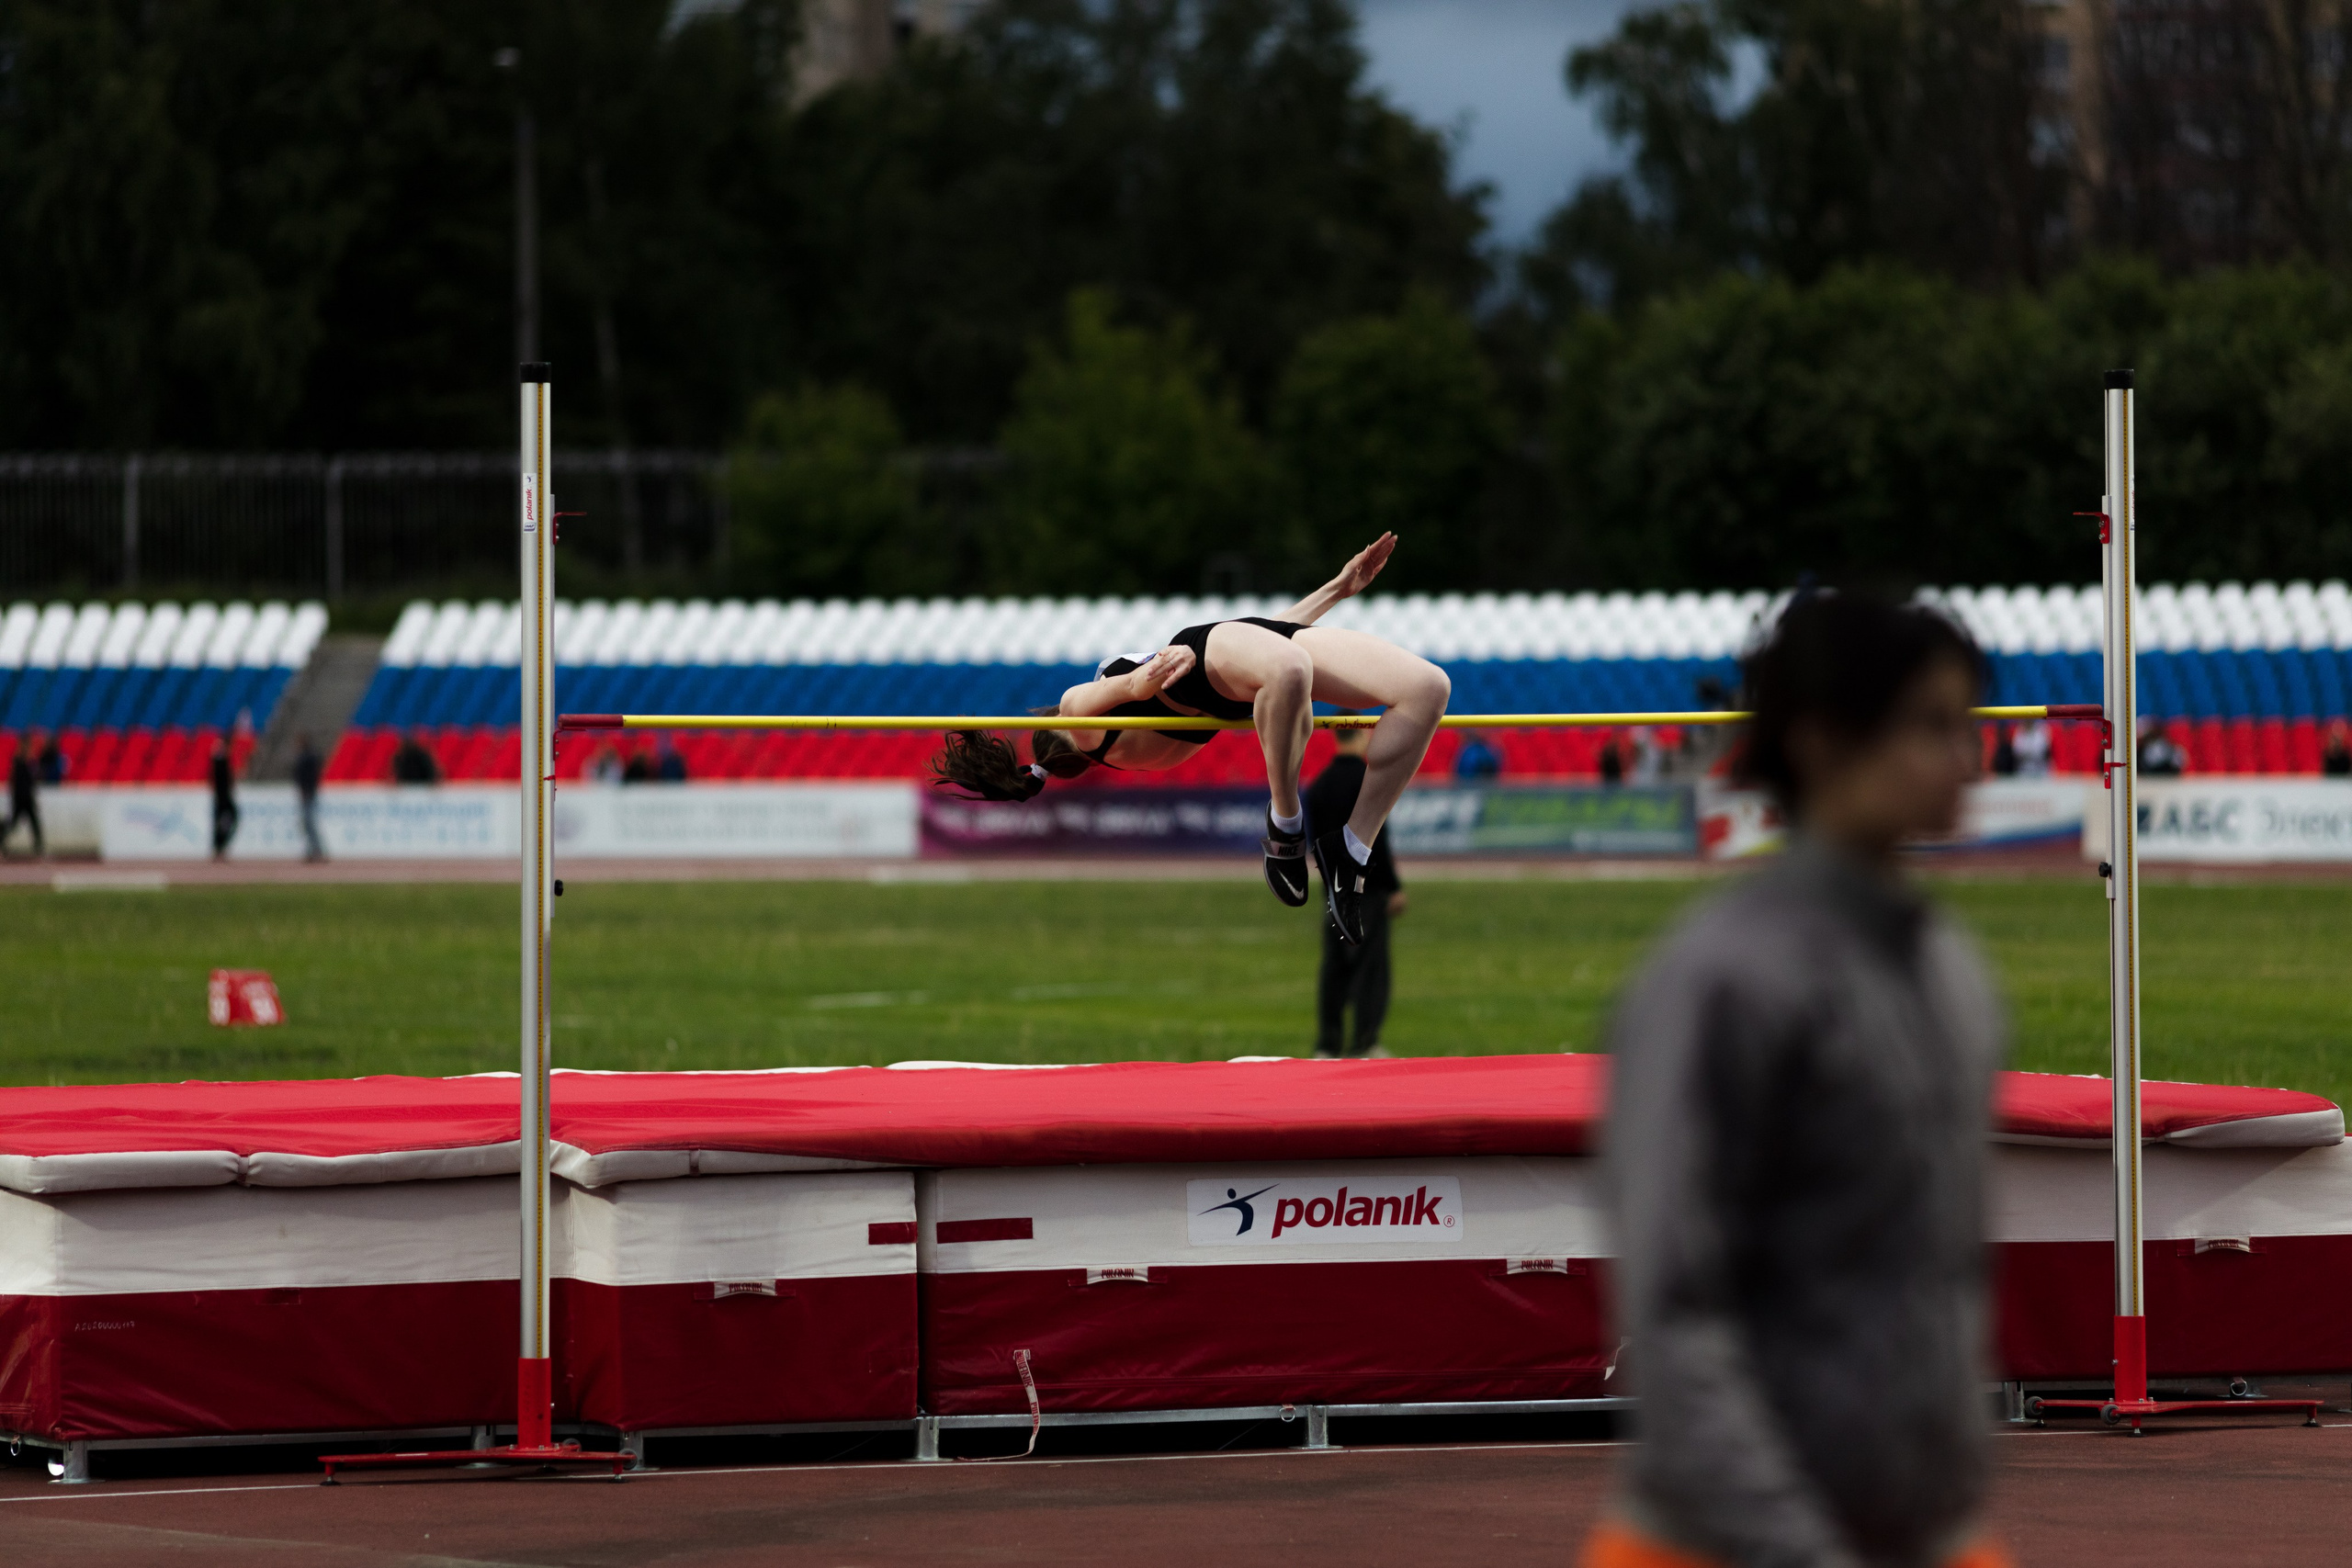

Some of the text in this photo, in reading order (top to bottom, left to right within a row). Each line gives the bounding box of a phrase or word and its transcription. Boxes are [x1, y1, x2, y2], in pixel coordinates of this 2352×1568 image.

[1278, 845, 1299, 856] NIKE
[1272, 1186, 1442, 1238] polanik
[1521, 1258, 1554, 1270] POLANIK
[1101, 1268, 1135, 1279] POLANIK
